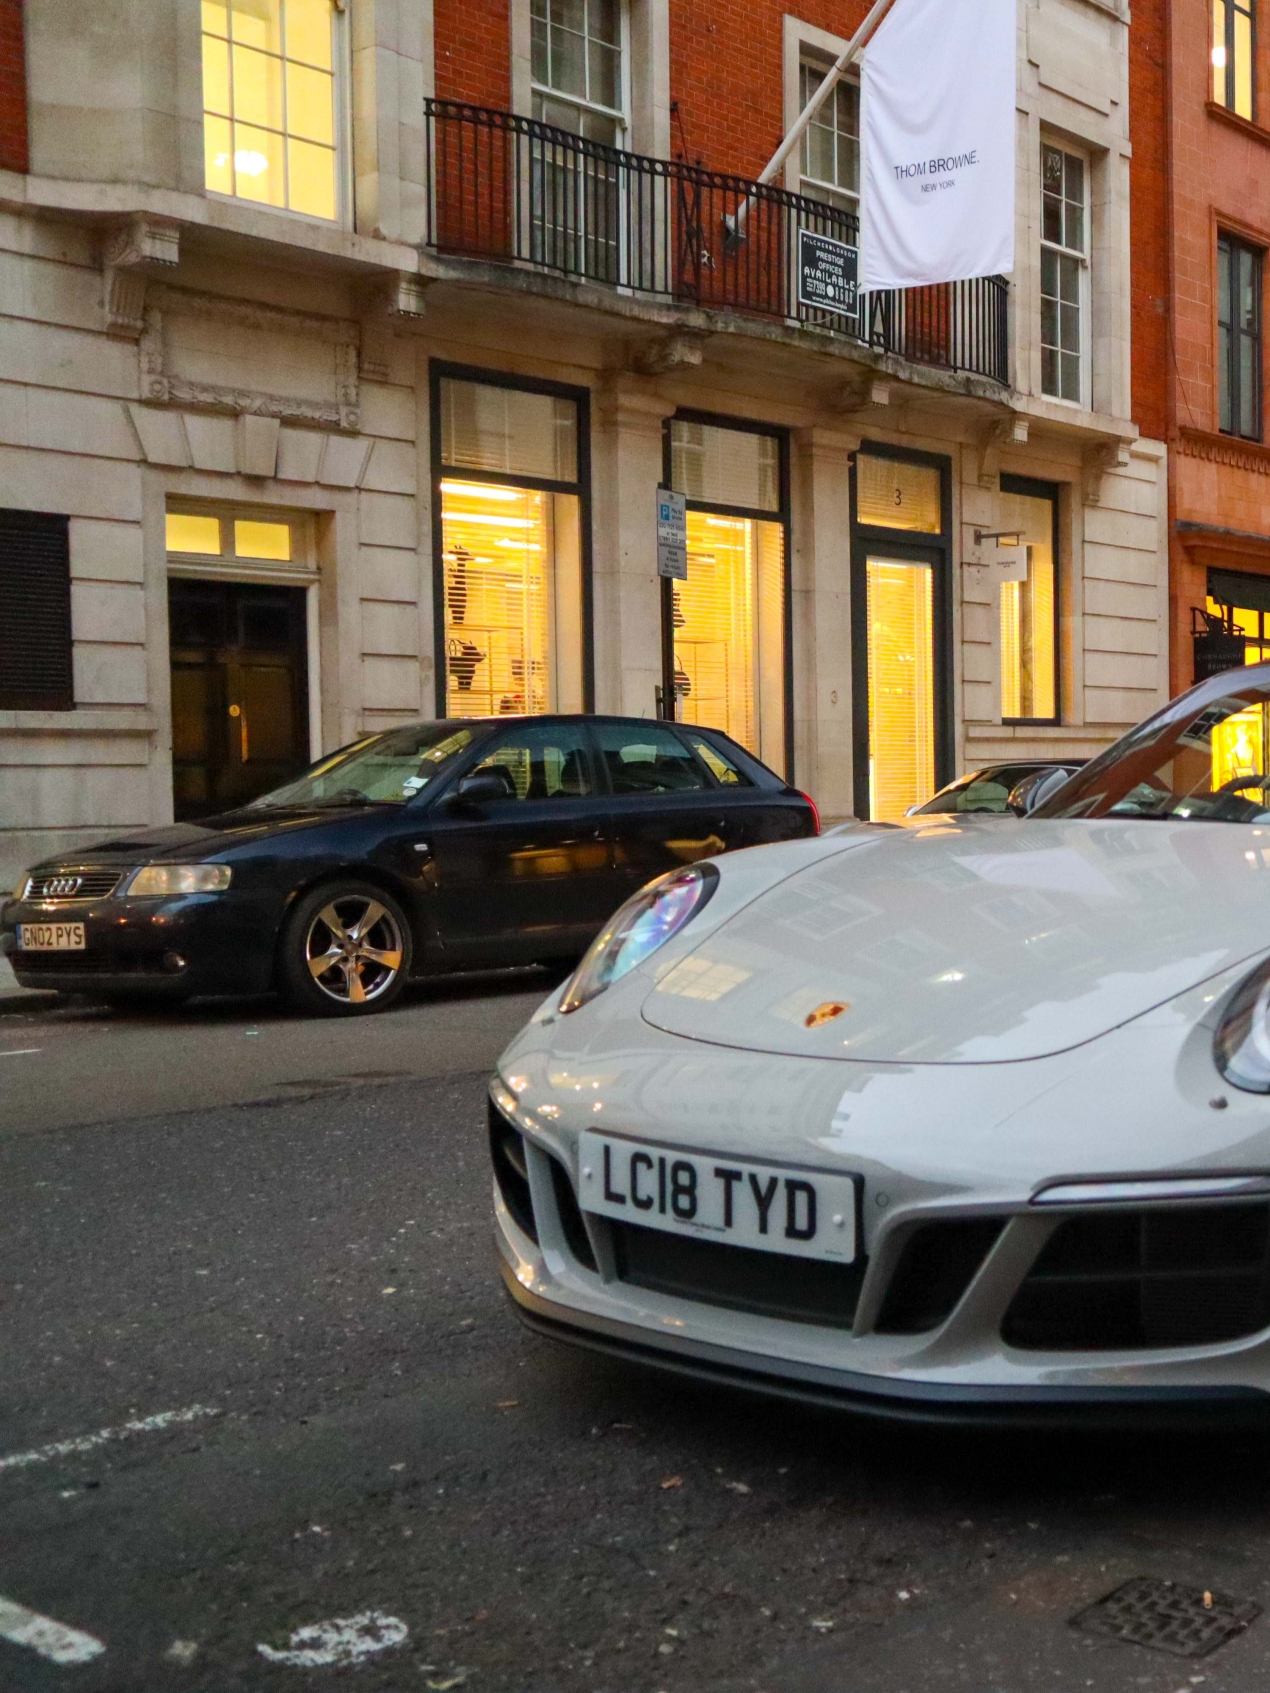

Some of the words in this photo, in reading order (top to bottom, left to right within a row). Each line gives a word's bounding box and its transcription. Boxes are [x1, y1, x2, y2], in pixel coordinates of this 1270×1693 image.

[894, 161, 926, 180] THOM
[929, 150, 980, 174] BROWNE.
[920, 183, 938, 193] NEW
[939, 179, 956, 191] YORK
[803, 236, 829, 250] PILCHER
[832, 246, 856, 259] LONDON
[816, 250, 845, 267] PRESTIGE
[818, 261, 843, 276] OFFICES
[803, 266, 855, 291] AVAILABLE
[895, 488, 902, 506] 3
[23, 927, 53, 947] GN02
[56, 926, 83, 946] PYS
[604, 1144, 697, 1219] LC18
[713, 1167, 817, 1241] TYD
